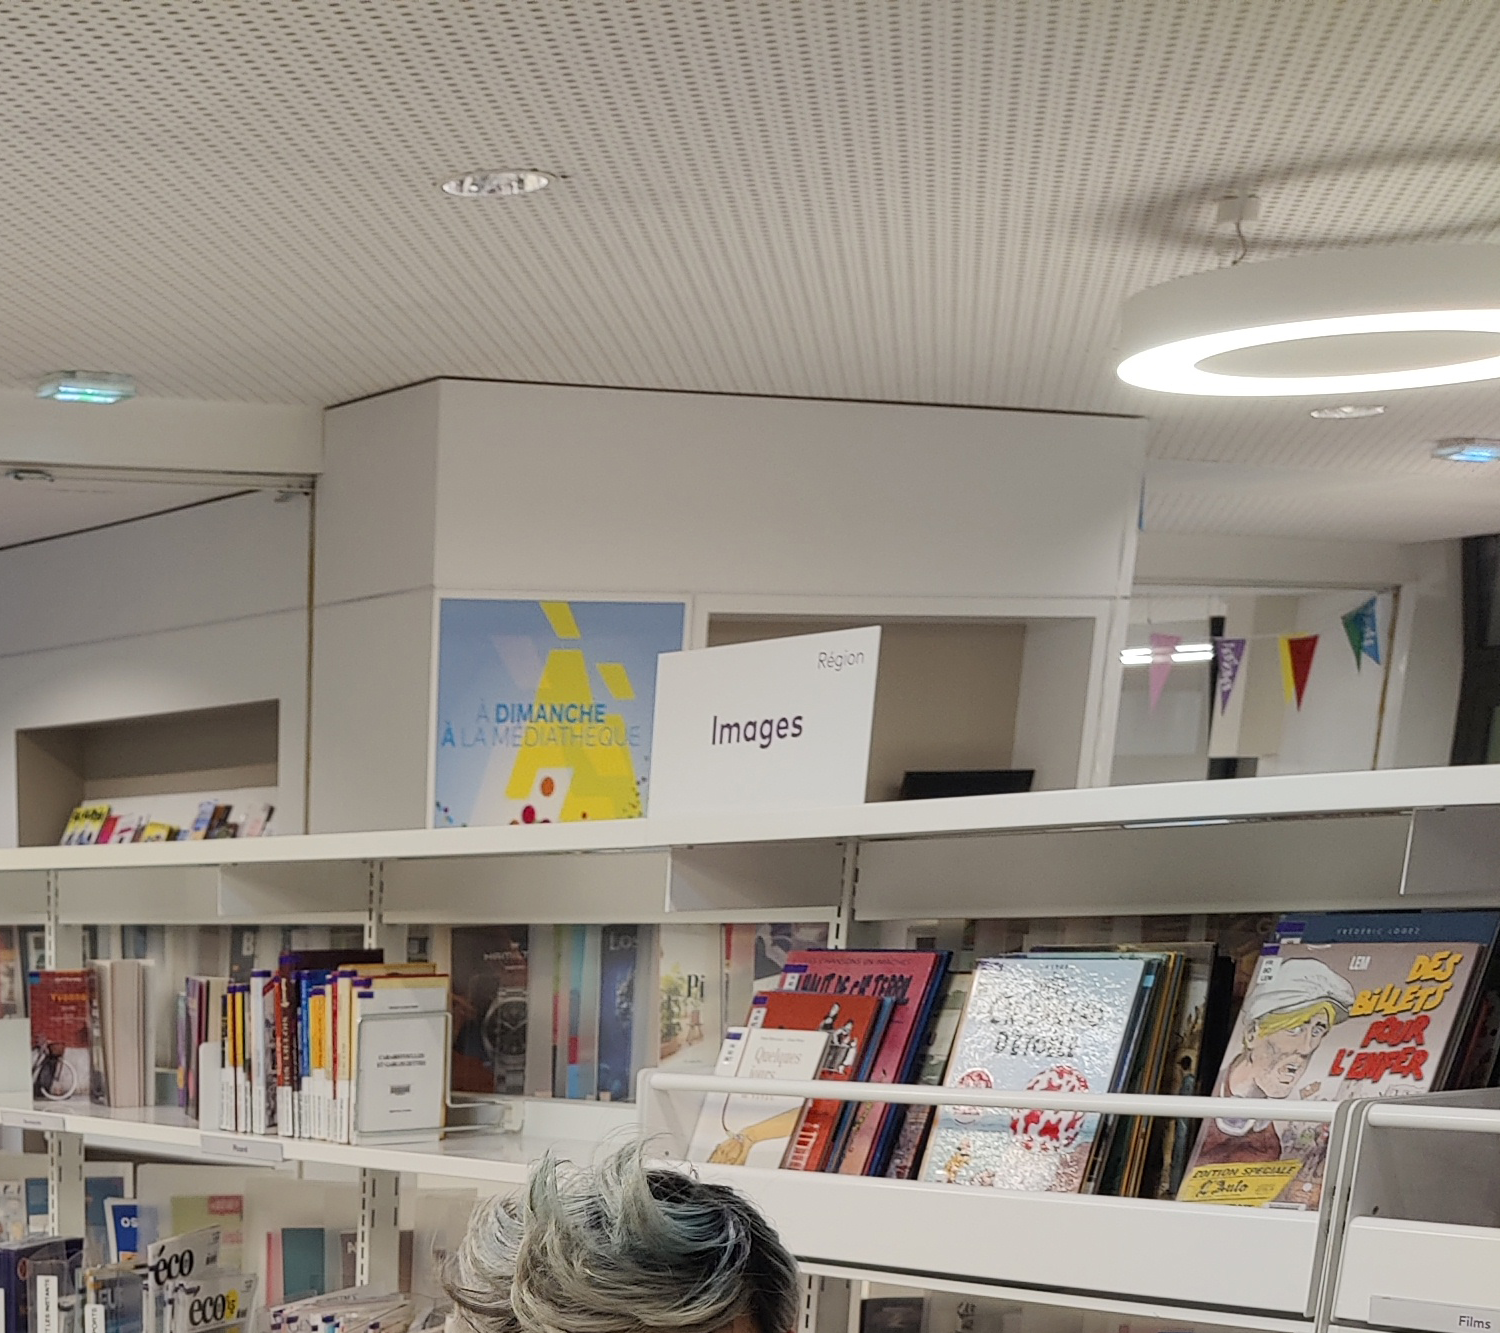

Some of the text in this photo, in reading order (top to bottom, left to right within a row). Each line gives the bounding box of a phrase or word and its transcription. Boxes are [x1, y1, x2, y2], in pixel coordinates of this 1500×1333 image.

[816, 648, 865, 673] Région
[495, 703, 608, 724] DIMANCHE
[711, 713, 804, 750] Images
[1349, 954, 1373, 971] LEM
[1406, 951, 1464, 983] DES
[1360, 1014, 1431, 1049] POUR
[1328, 1047, 1430, 1083] L'ENFER
[1458, 1315, 1492, 1330] Films
